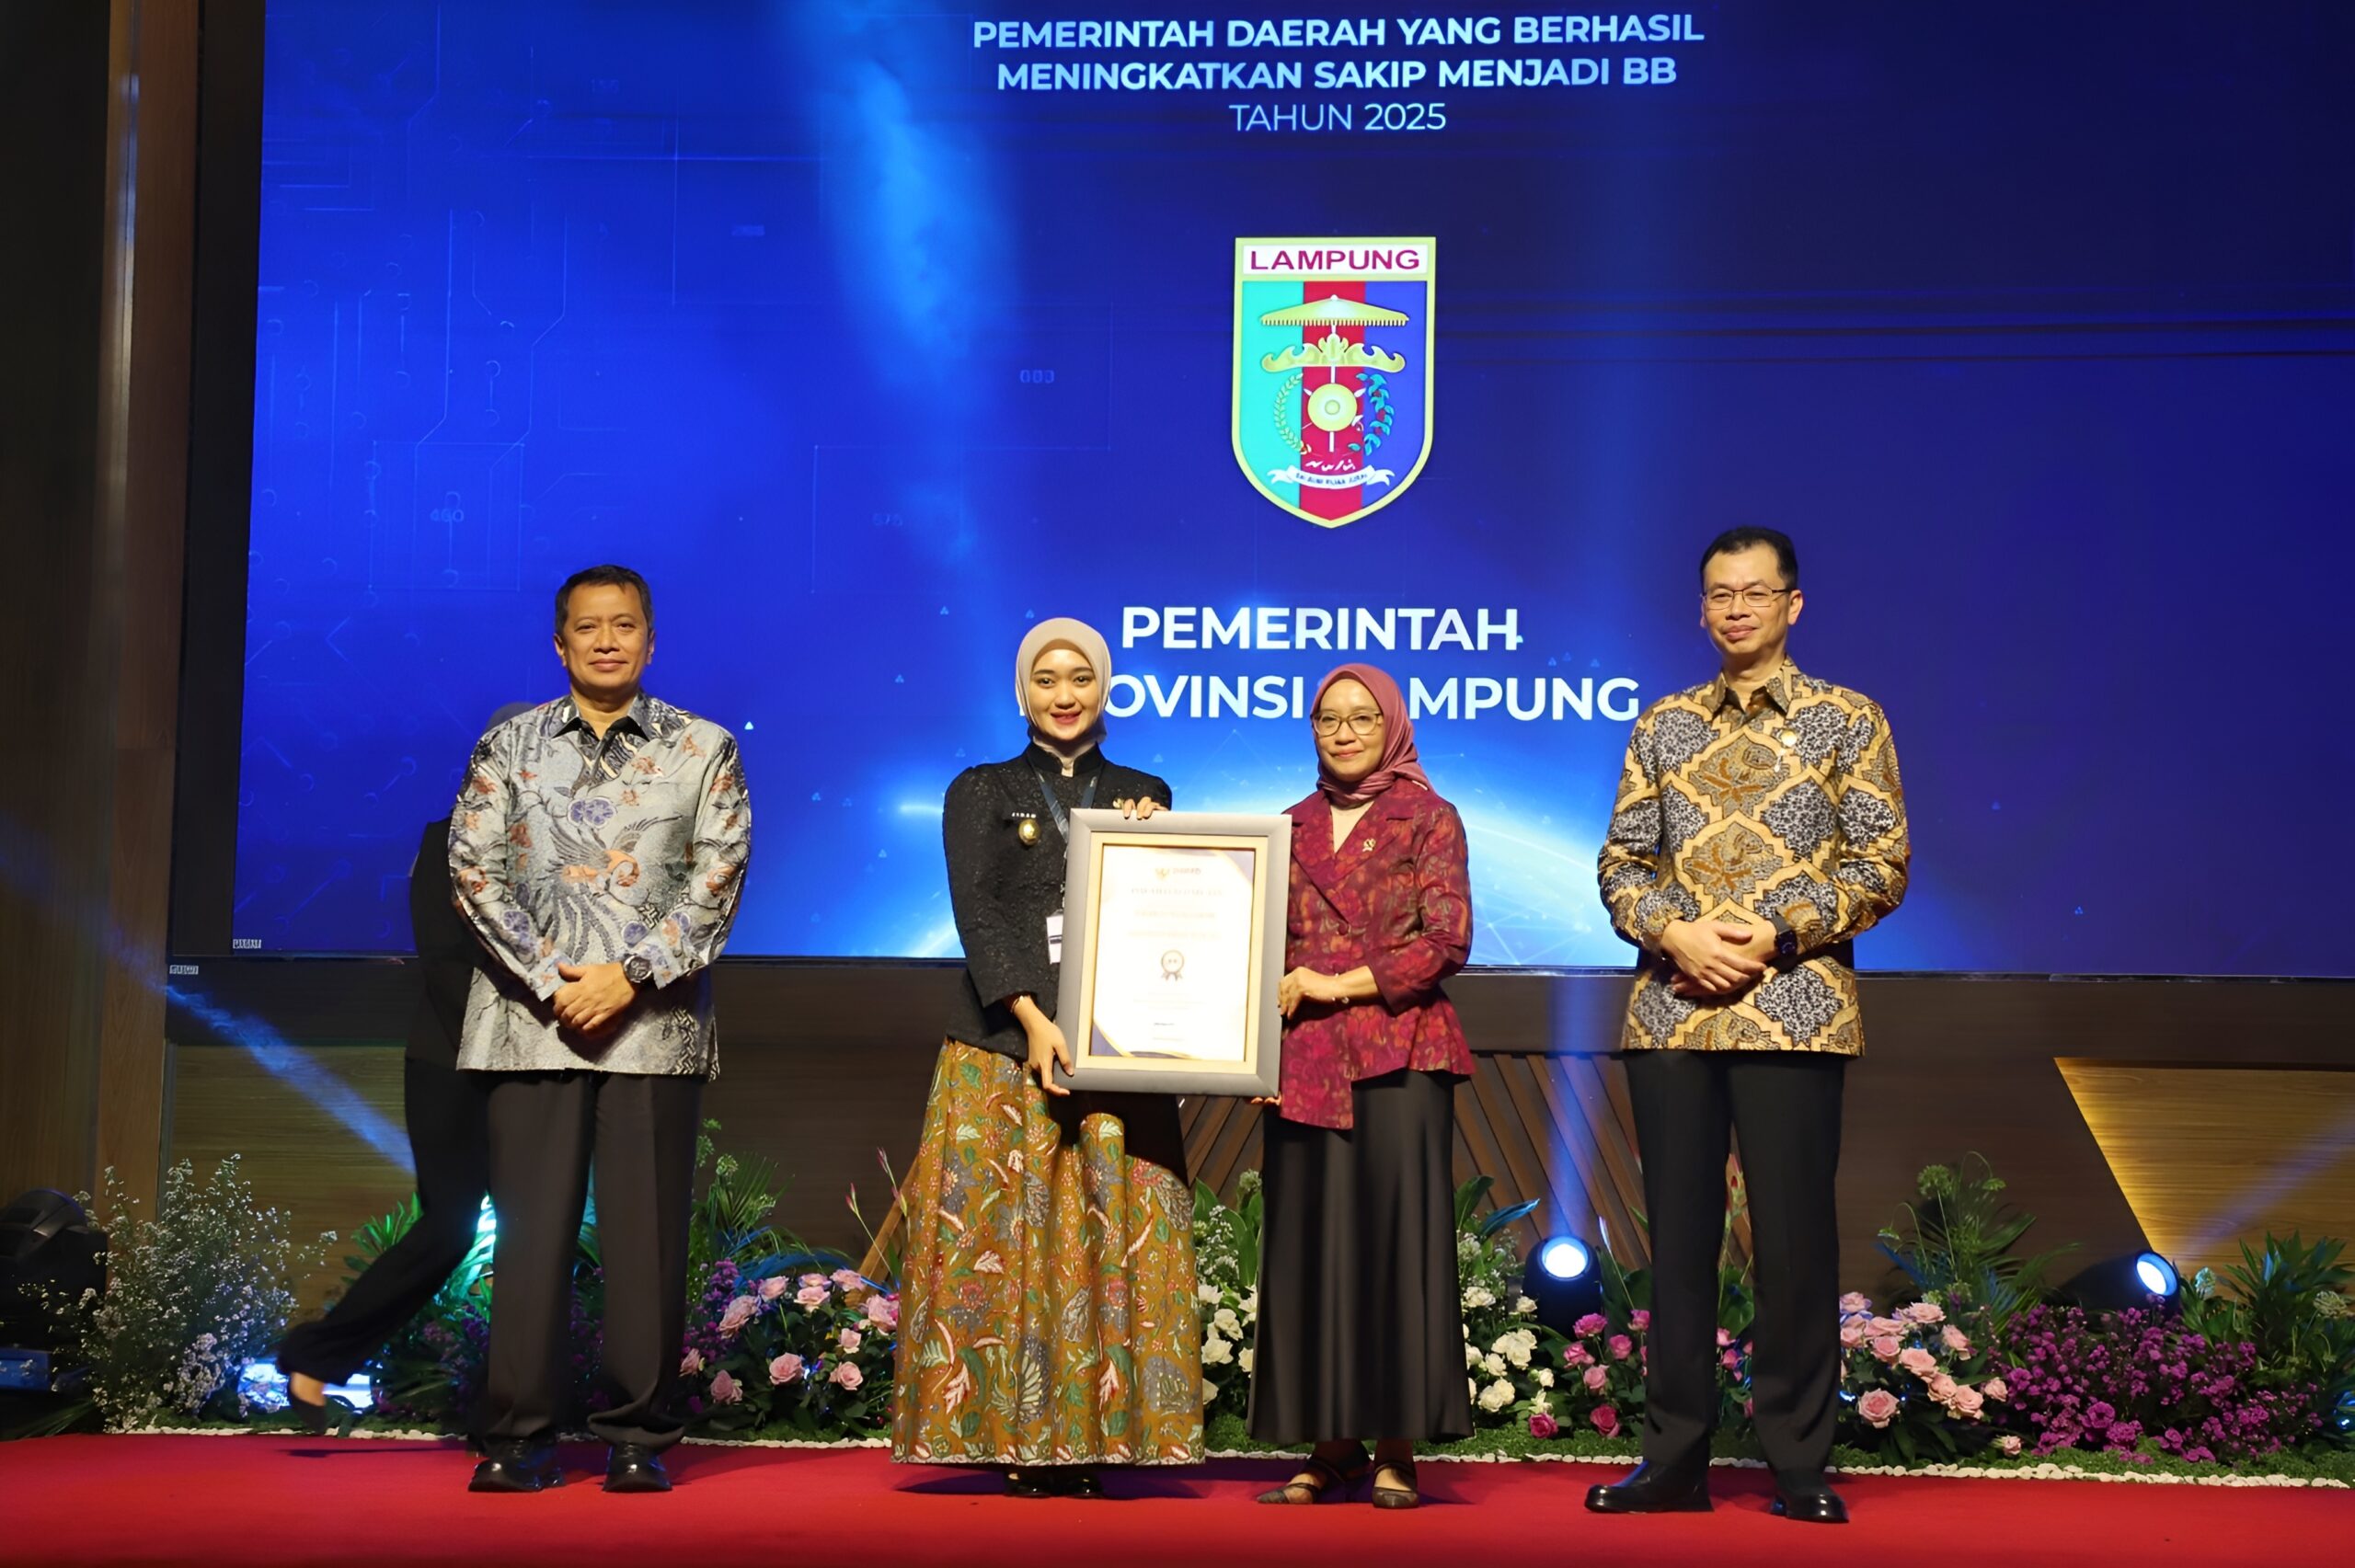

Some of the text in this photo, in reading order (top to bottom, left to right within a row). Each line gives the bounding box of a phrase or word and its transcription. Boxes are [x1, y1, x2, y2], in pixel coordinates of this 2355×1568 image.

[973, 14, 1705, 48] PEMERINTAH DAERAH YANG BERHASIL
[997, 57, 1677, 90] MENINGKATKAN SAKIP MENJADI BB
[1228, 102, 1447, 132] TAHUN 2025
[1250, 249, 1420, 270] LAMPUNG
[1121, 606, 1520, 651] PEMERINTAH
[1019, 674, 1640, 721] OVINSI MPUNG
